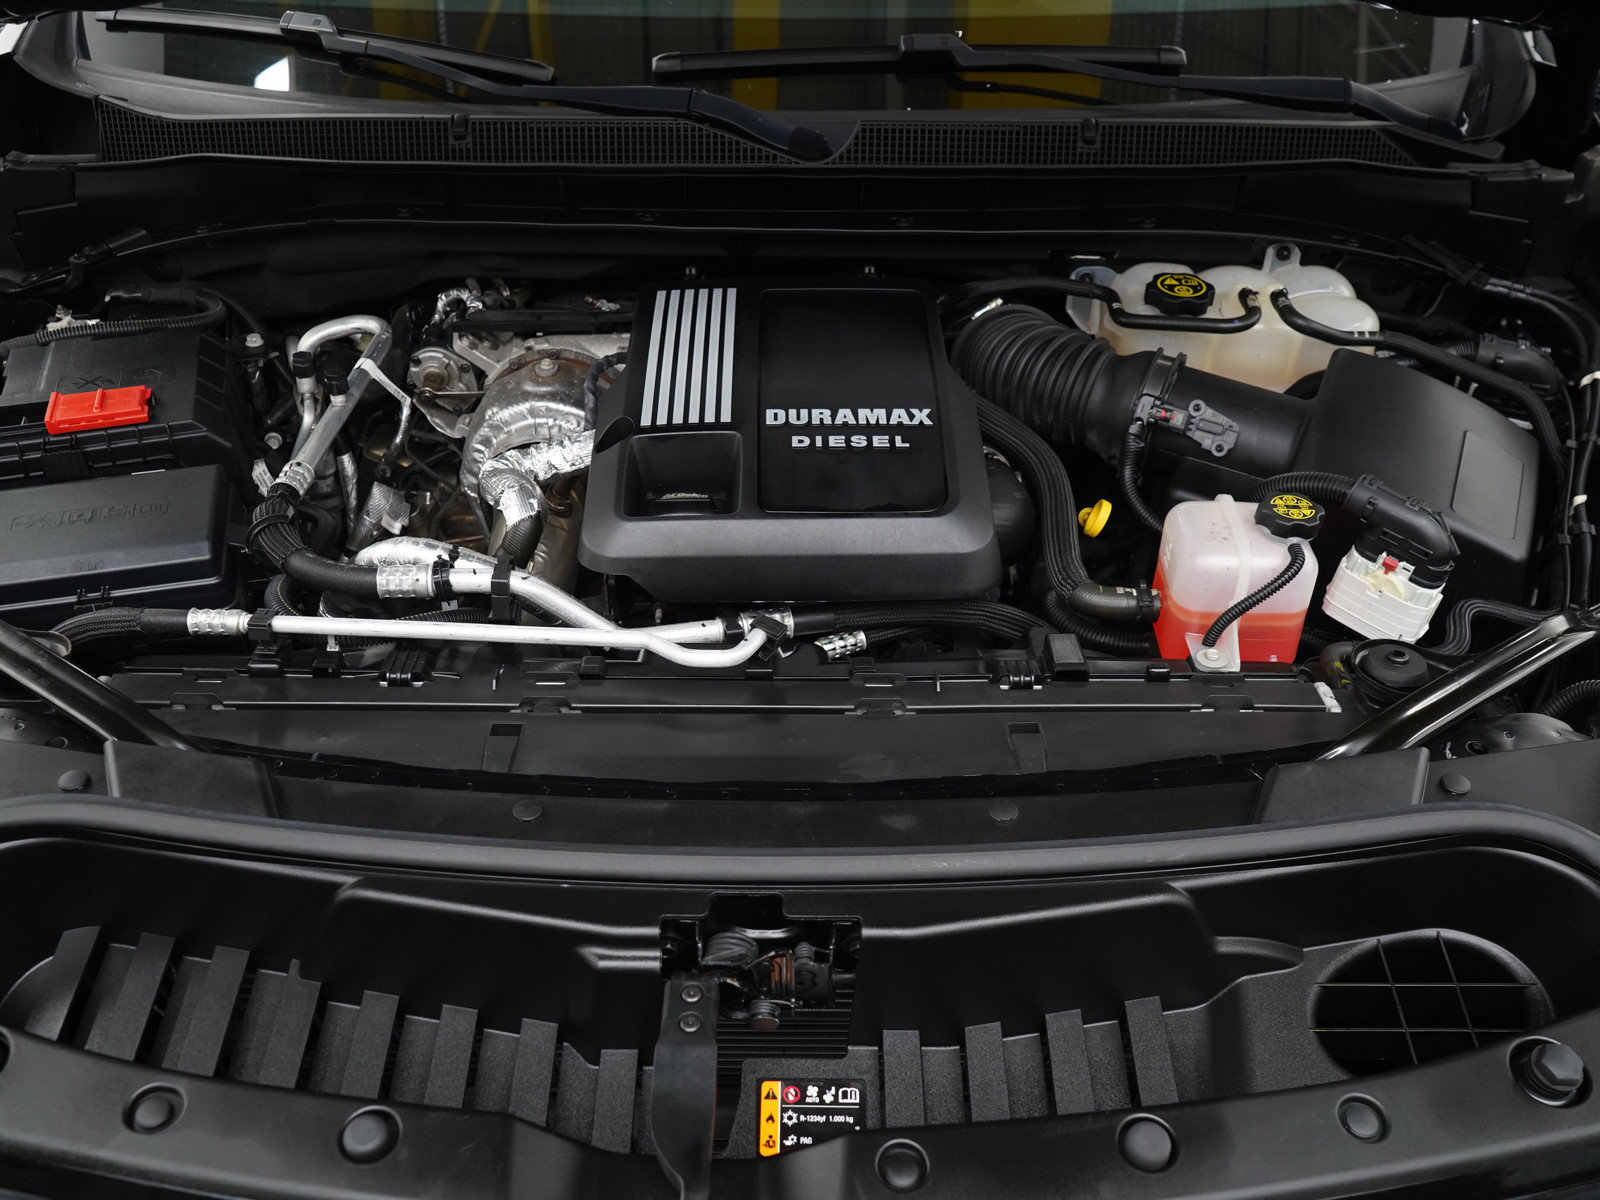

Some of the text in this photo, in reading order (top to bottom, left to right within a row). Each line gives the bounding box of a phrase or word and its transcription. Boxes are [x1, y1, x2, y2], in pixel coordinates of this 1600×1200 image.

[765, 408, 933, 426] DURAMAX
[791, 434, 910, 449] DIESEL
[800, 1115, 826, 1124] R-1234yf
[846, 1115, 854, 1124] kg
[800, 1136, 813, 1144] PAG
